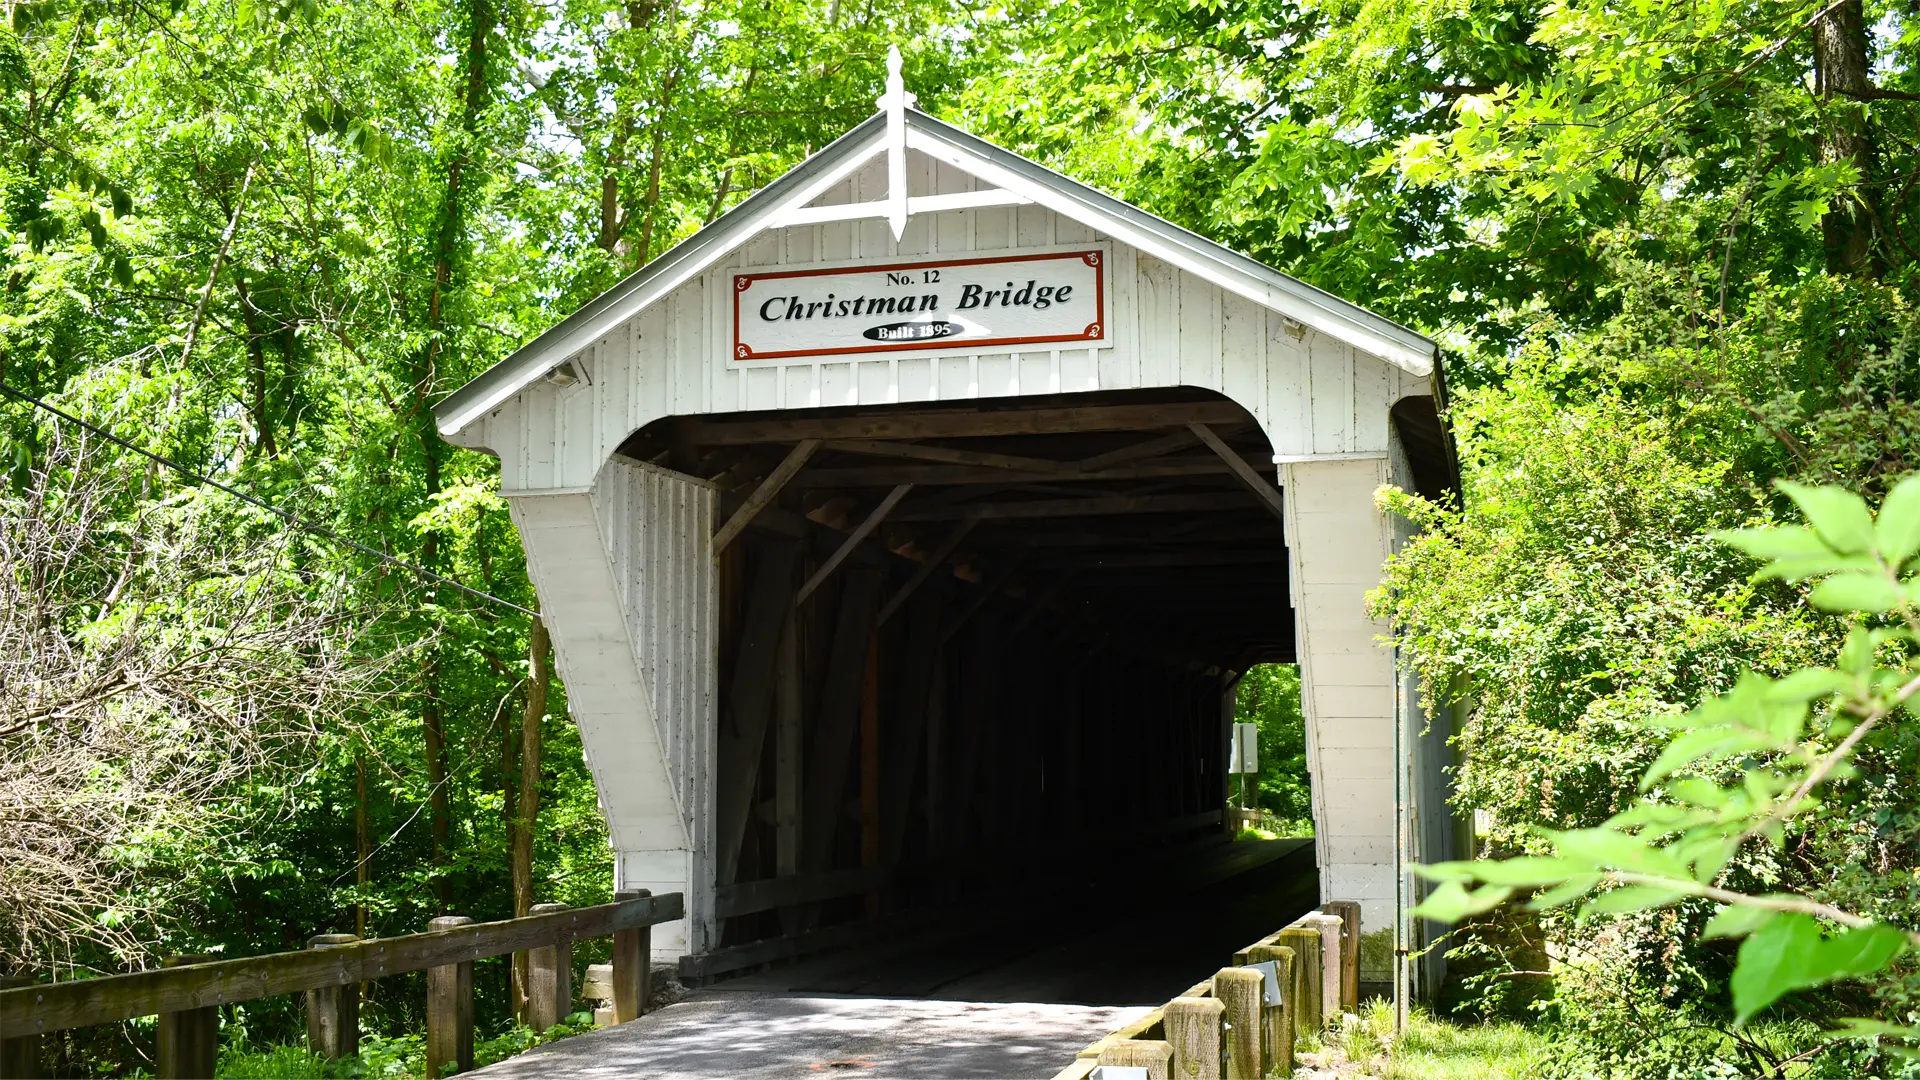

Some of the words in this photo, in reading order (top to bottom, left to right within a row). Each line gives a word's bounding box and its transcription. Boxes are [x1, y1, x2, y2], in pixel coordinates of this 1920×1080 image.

[886, 273, 915, 287] No.
[923, 270, 941, 284] 12
[759, 291, 939, 322] Christman
[956, 280, 1073, 310] Bridge
[877, 326, 914, 340] Built
[919, 323, 951, 337] 1895
